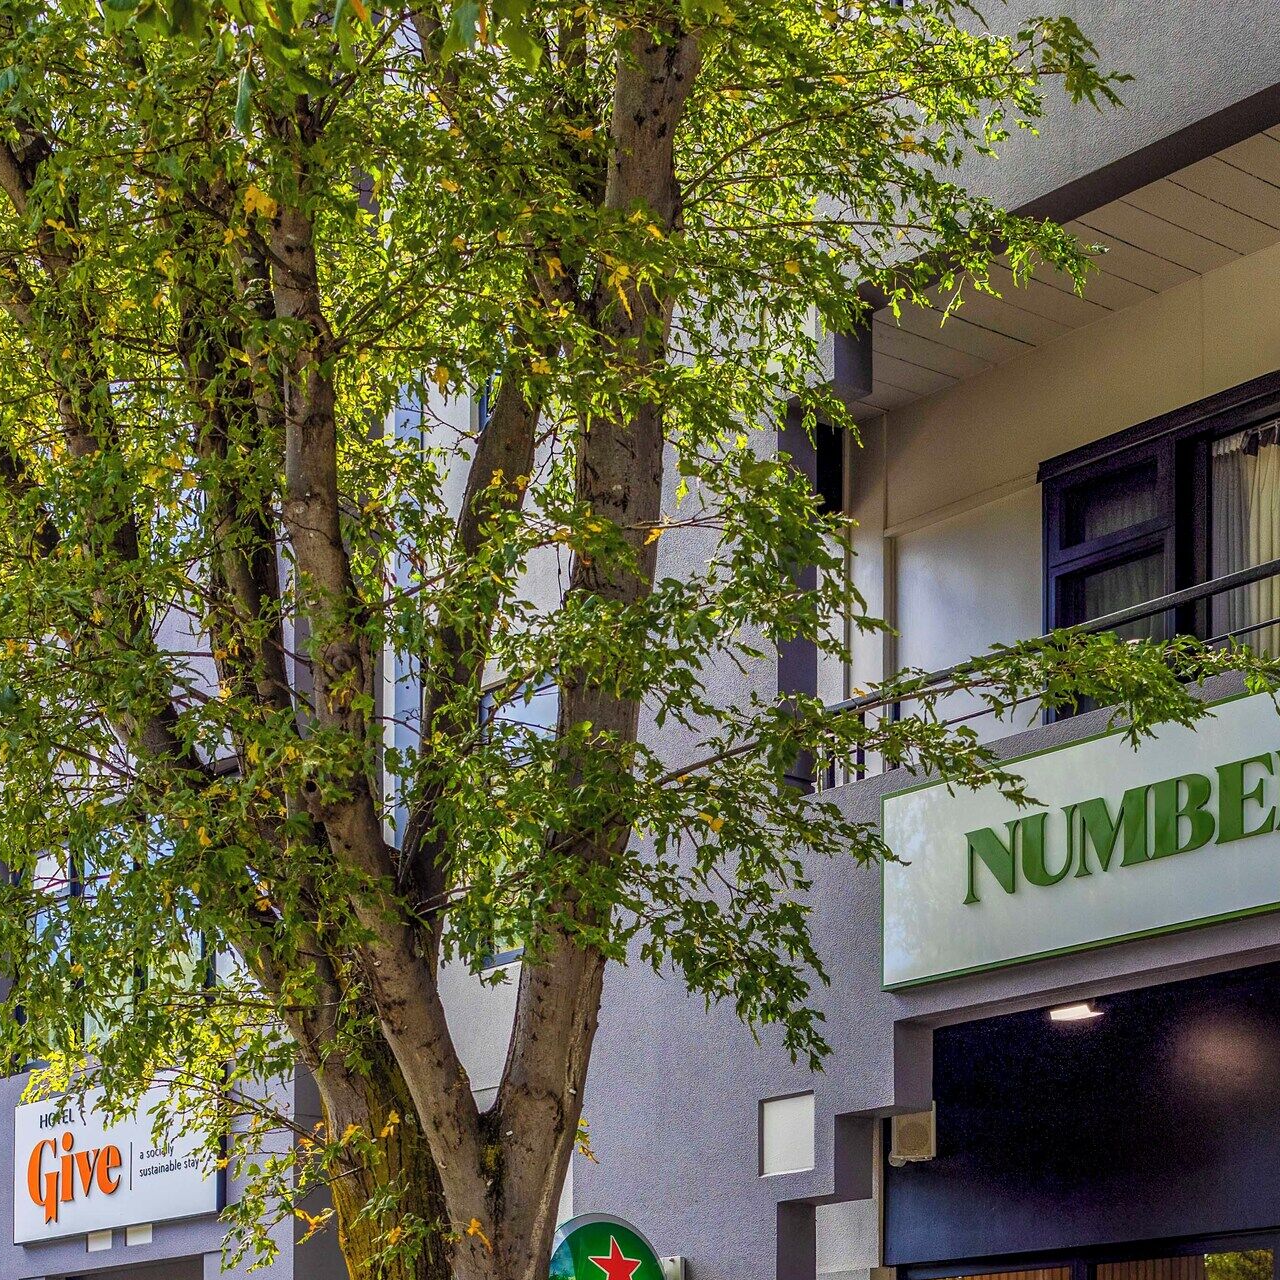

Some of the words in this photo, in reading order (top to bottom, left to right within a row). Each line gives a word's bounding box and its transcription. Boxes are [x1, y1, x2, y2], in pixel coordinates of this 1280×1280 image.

[39, 1108, 75, 1129] HOEL
[139, 1151, 144, 1160] a
[146, 1142, 174, 1159] socilly
[139, 1159, 182, 1177] sustainable
[183, 1159, 199, 1170] stay
[27, 1131, 122, 1225] Give
